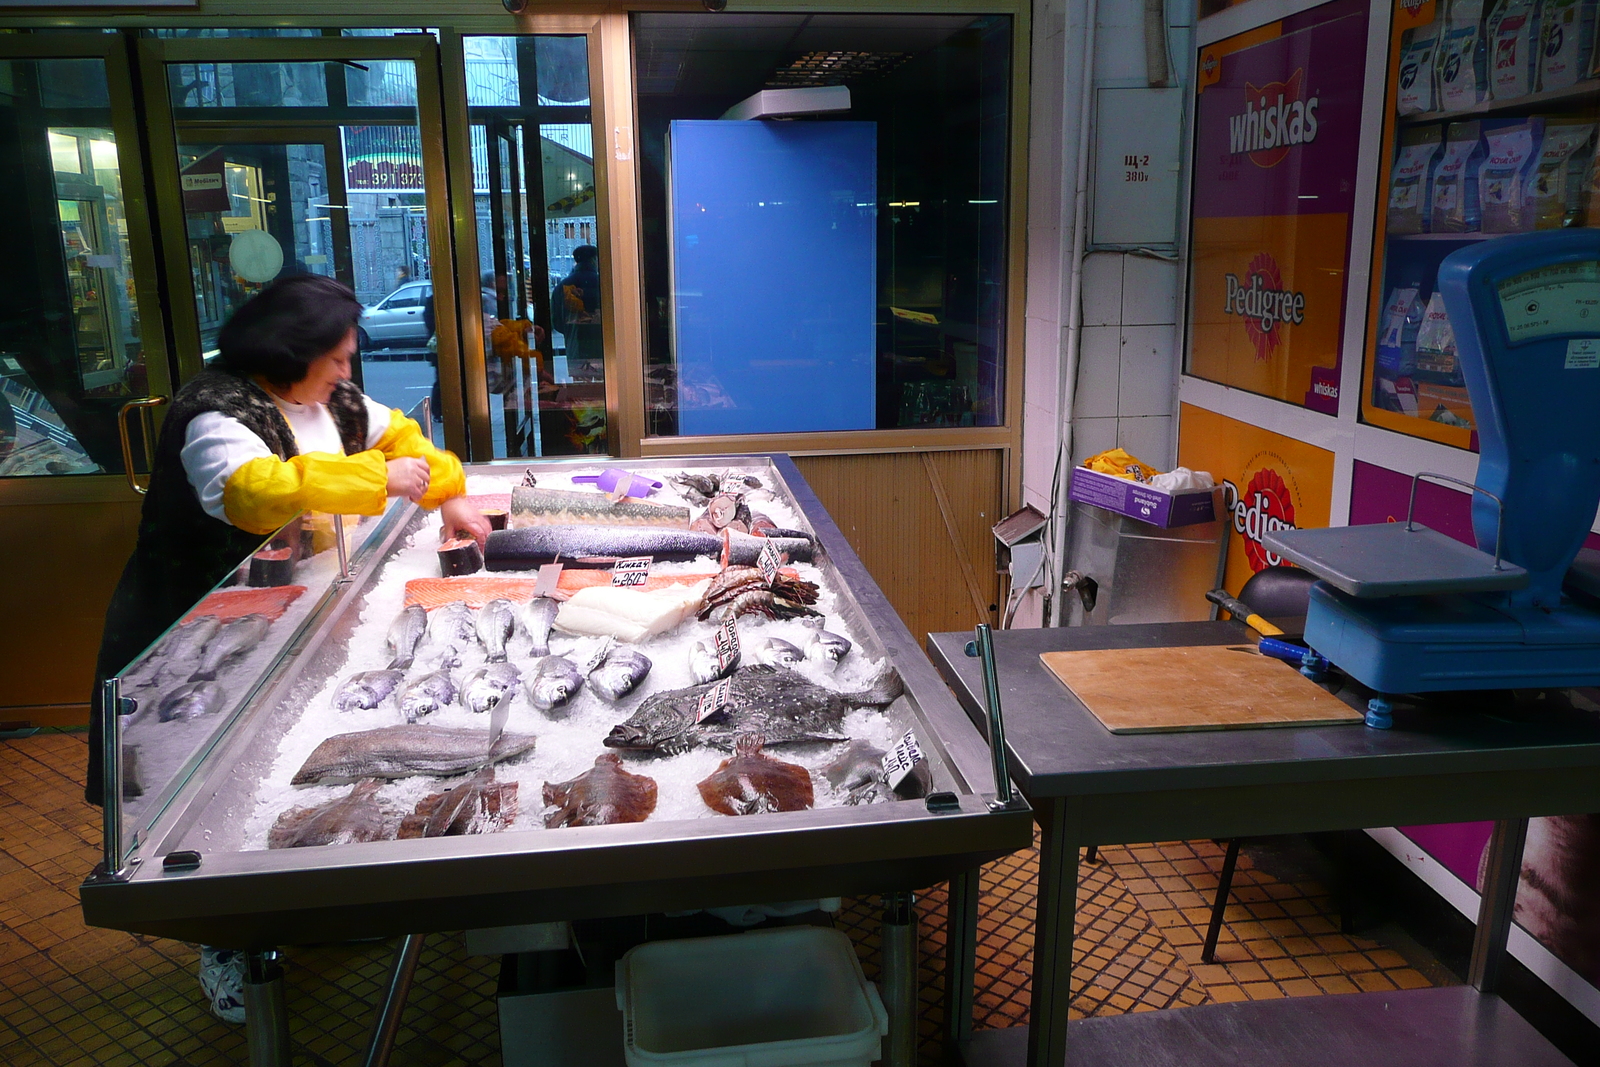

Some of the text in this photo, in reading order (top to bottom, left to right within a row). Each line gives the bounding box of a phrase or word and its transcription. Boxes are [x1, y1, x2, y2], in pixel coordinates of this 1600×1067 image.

[1229, 93, 1319, 154] whiskas
[371, 173, 395, 185] 391
[1224, 273, 1305, 333] Pedigree
[1313, 381, 1338, 399] whiskas
[1134, 496, 1158, 510] Subland
[620, 572, 642, 586] 260
